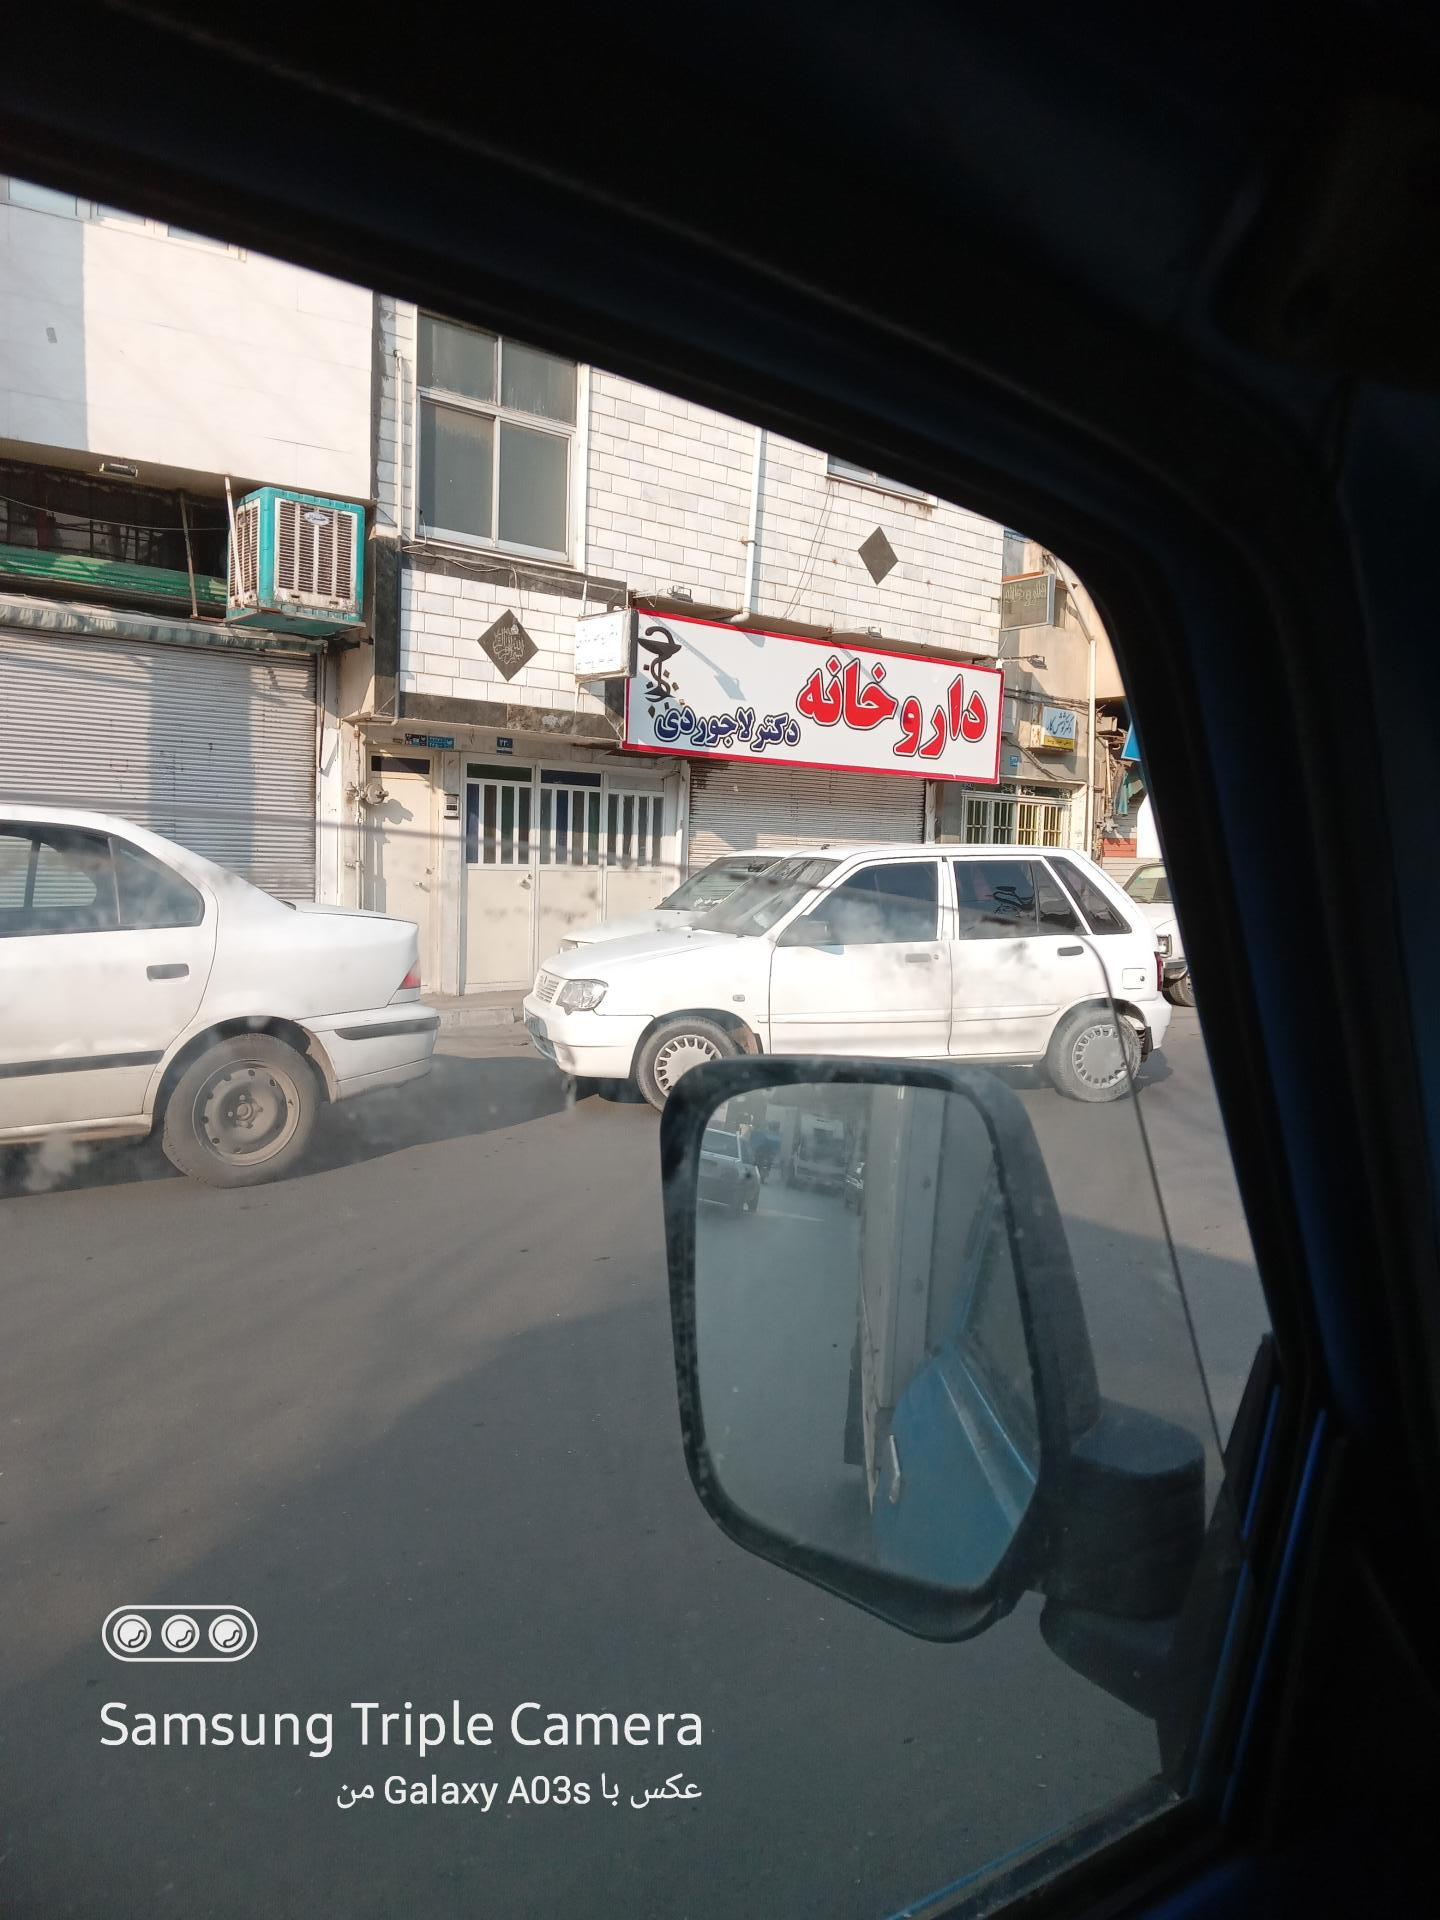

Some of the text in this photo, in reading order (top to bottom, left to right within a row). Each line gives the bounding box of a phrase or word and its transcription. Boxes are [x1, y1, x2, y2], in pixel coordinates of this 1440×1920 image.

[654, 706, 801, 752] دکتر لاجوردی
[797, 655, 987, 759] داروخانه
